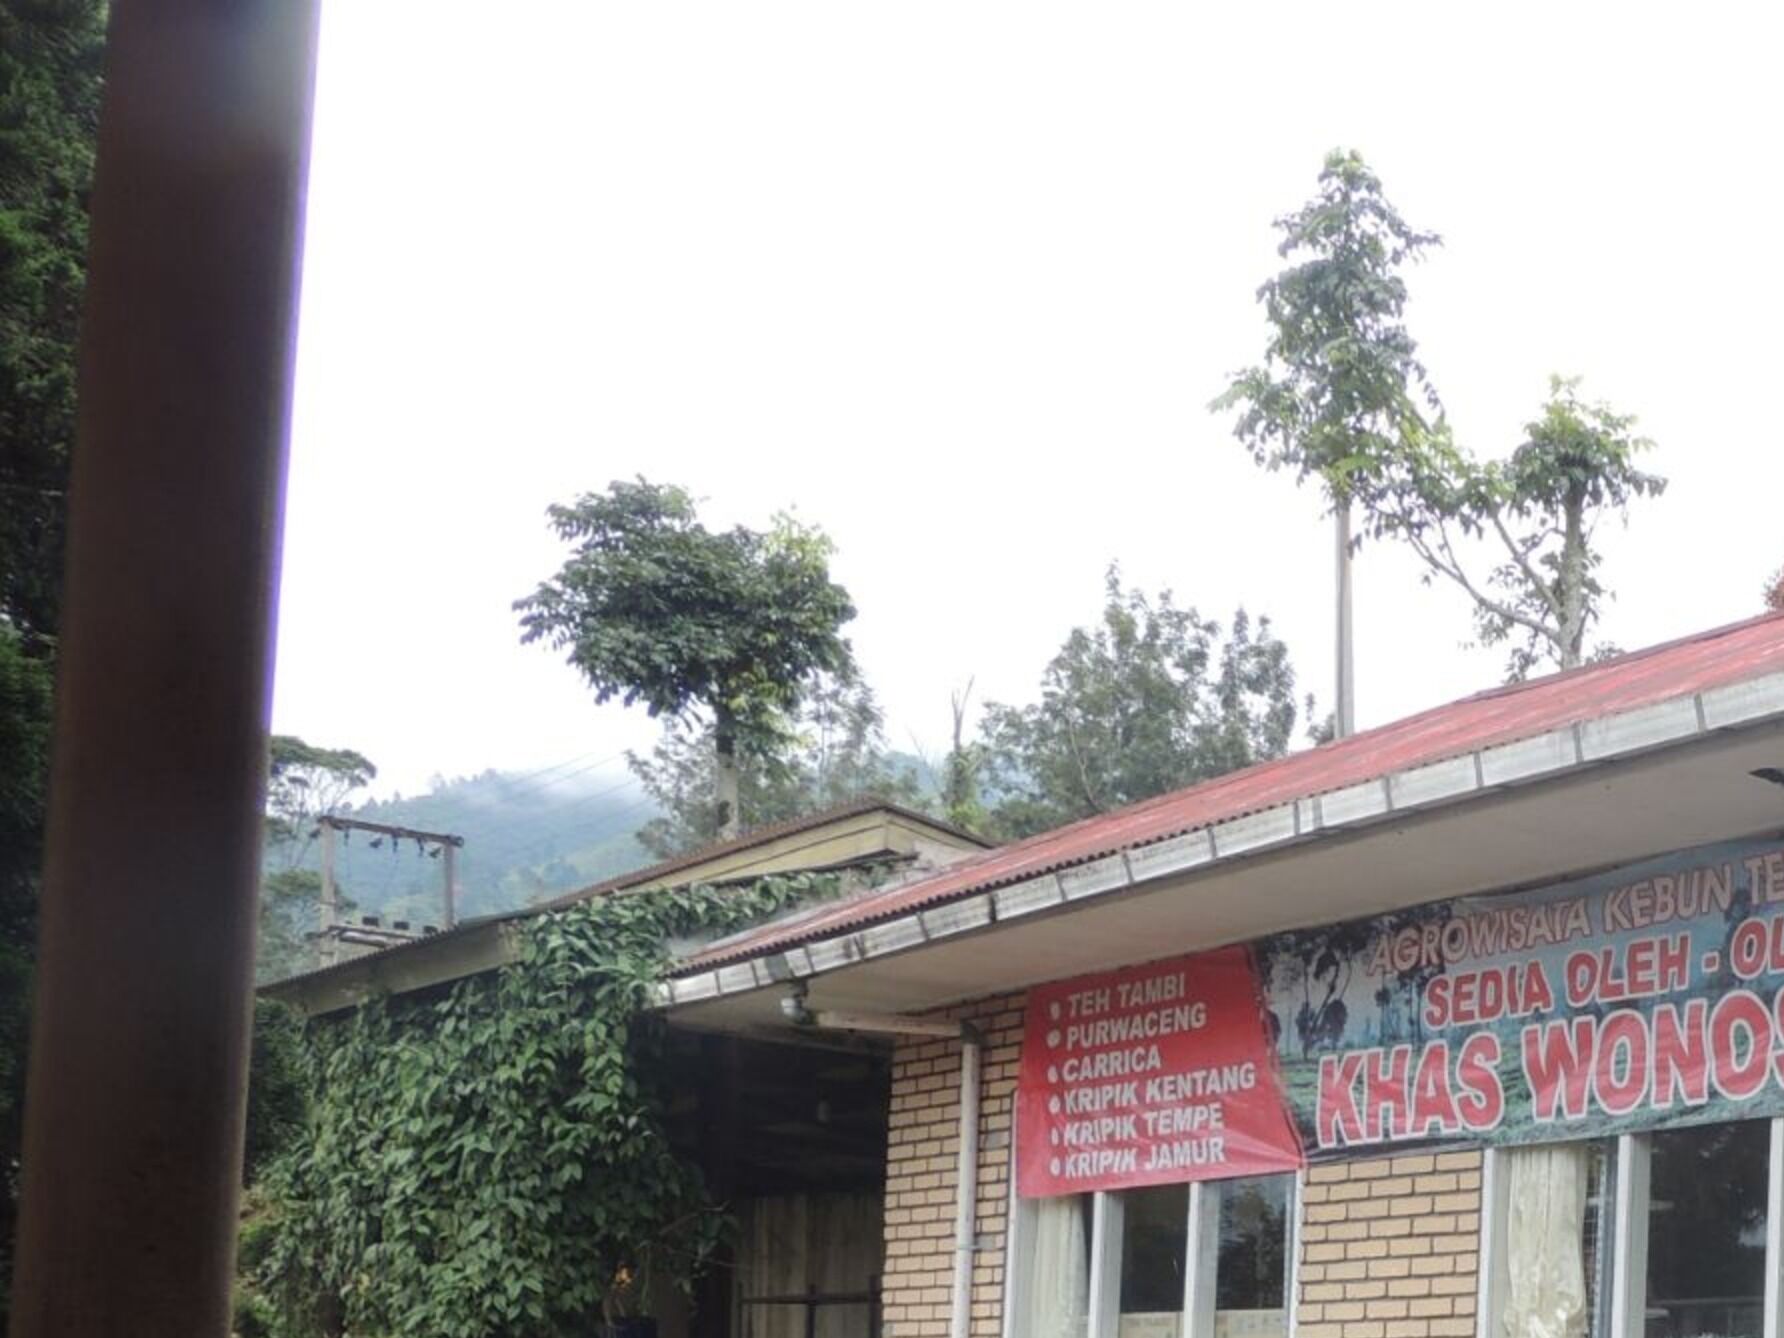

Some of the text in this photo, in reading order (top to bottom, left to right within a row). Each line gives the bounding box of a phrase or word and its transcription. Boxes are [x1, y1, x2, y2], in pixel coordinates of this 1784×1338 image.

[1366, 898, 1592, 977] AGROWISATA
[1603, 863, 1732, 933] KEBUN
[1068, 973, 1186, 1017] TEH TAMBI
[1423, 956, 1553, 1031] SEDIA
[1564, 931, 1691, 1006] OLEH
[1066, 1002, 1207, 1050] PURWACENG
[1062, 1045, 1161, 1082] CARRICA
[1064, 1062, 1255, 1115] KRIPIK KENTANG
[1315, 1030, 1504, 1149] KHAS
[1063, 1103, 1224, 1147] KRIPIK TEMPE
[1064, 1136, 1226, 1179] KRIPIK JAMUR
